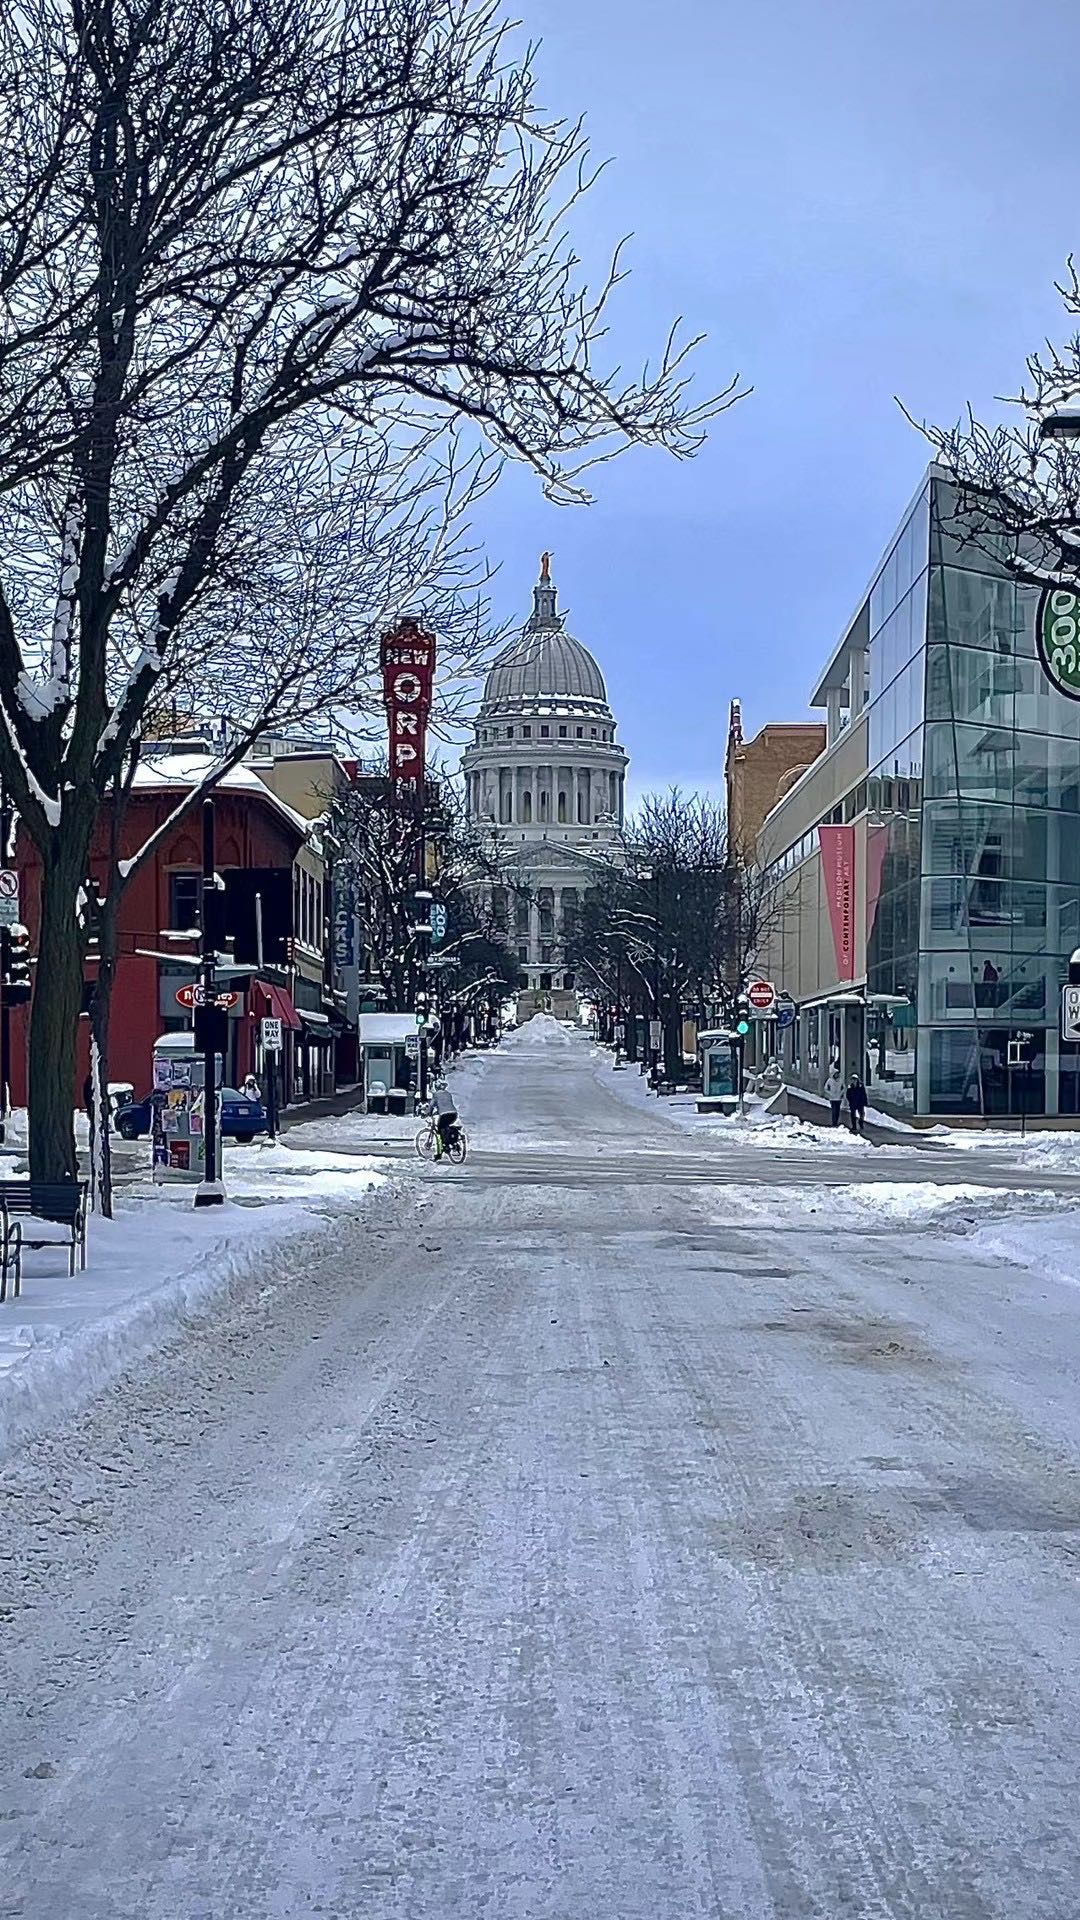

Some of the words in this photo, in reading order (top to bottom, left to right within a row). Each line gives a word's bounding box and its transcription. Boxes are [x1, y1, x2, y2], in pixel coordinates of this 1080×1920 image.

[1051, 590, 1077, 677] 300
[386, 649, 429, 666] NEW
[436, 904, 446, 937] 200
[842, 879, 850, 952] CONTEMPORARY
[264, 1021, 279, 1029] ONE
[264, 1030, 279, 1038] WAY
